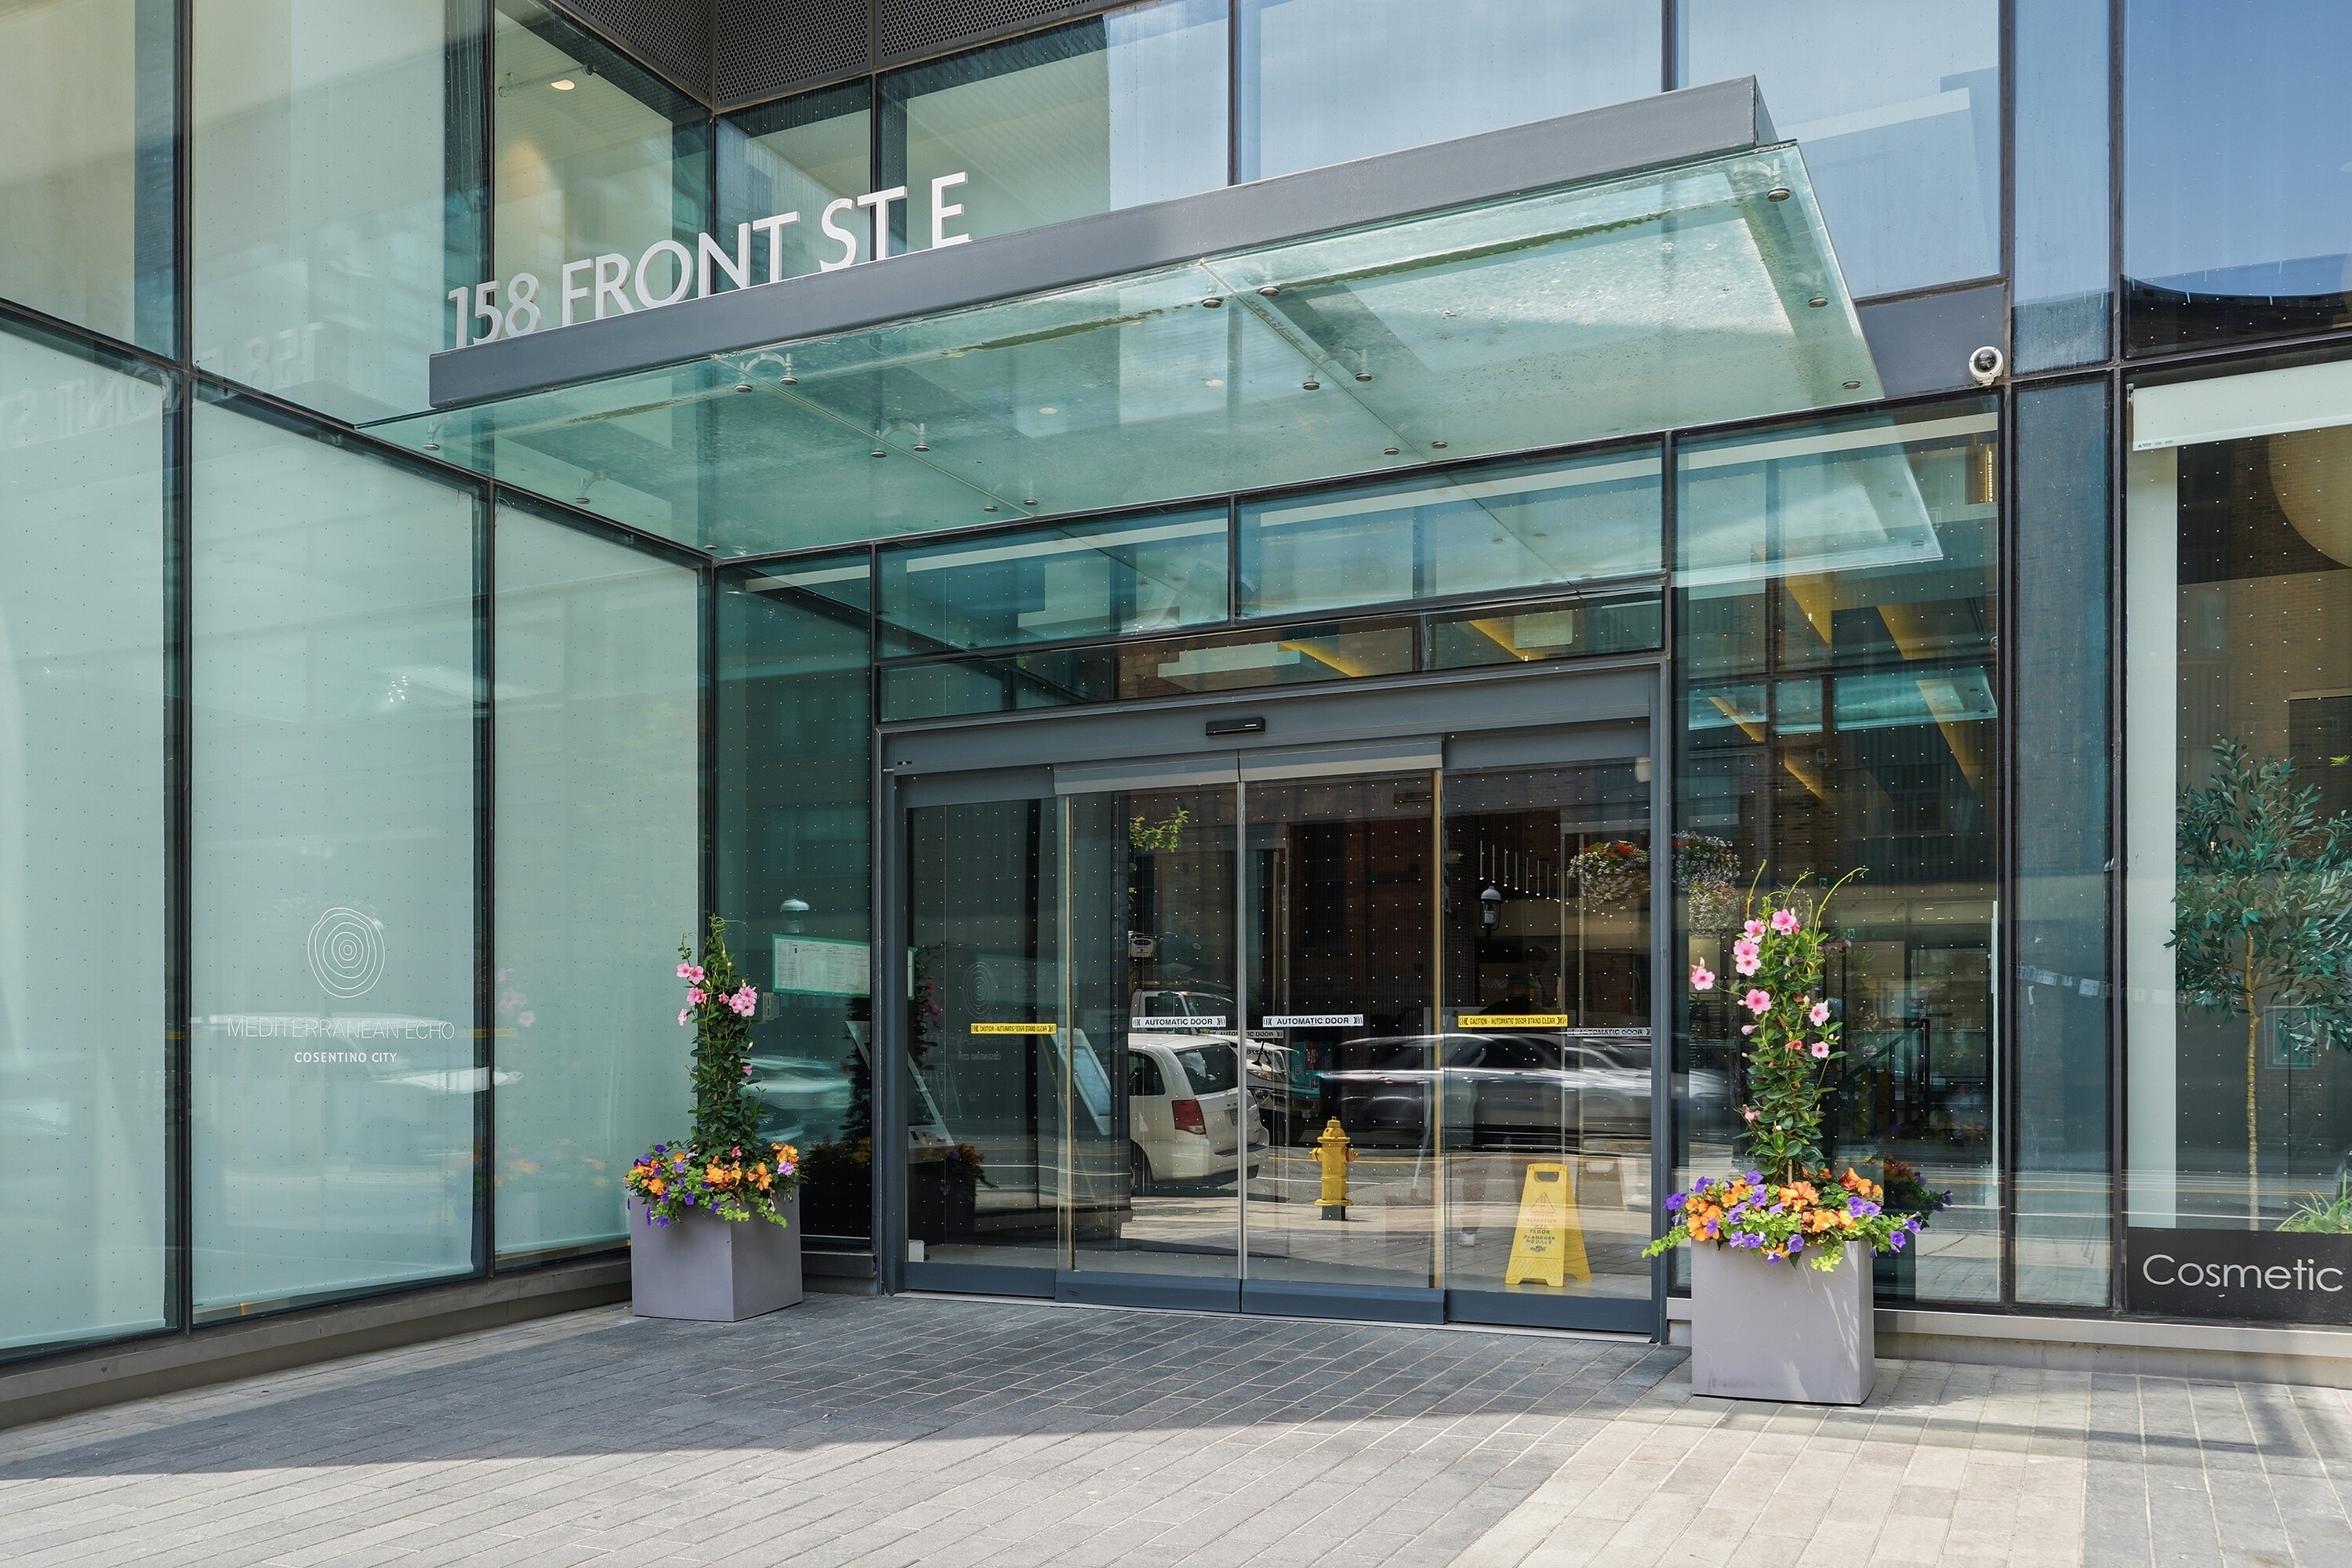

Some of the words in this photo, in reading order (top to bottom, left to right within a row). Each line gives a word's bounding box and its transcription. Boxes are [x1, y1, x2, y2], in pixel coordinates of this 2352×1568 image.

[447, 272, 541, 350] 158
[561, 210, 800, 328] FRONT
[818, 185, 908, 273] ST
[931, 171, 973, 249] E
[227, 1017, 400, 1040] MEDITERRANEAN
[405, 1020, 456, 1040] ECHO
[294, 1051, 367, 1063] COSENTINO
[372, 1051, 397, 1063] CITY
[2142, 1254, 2344, 1292] Cosmetic
